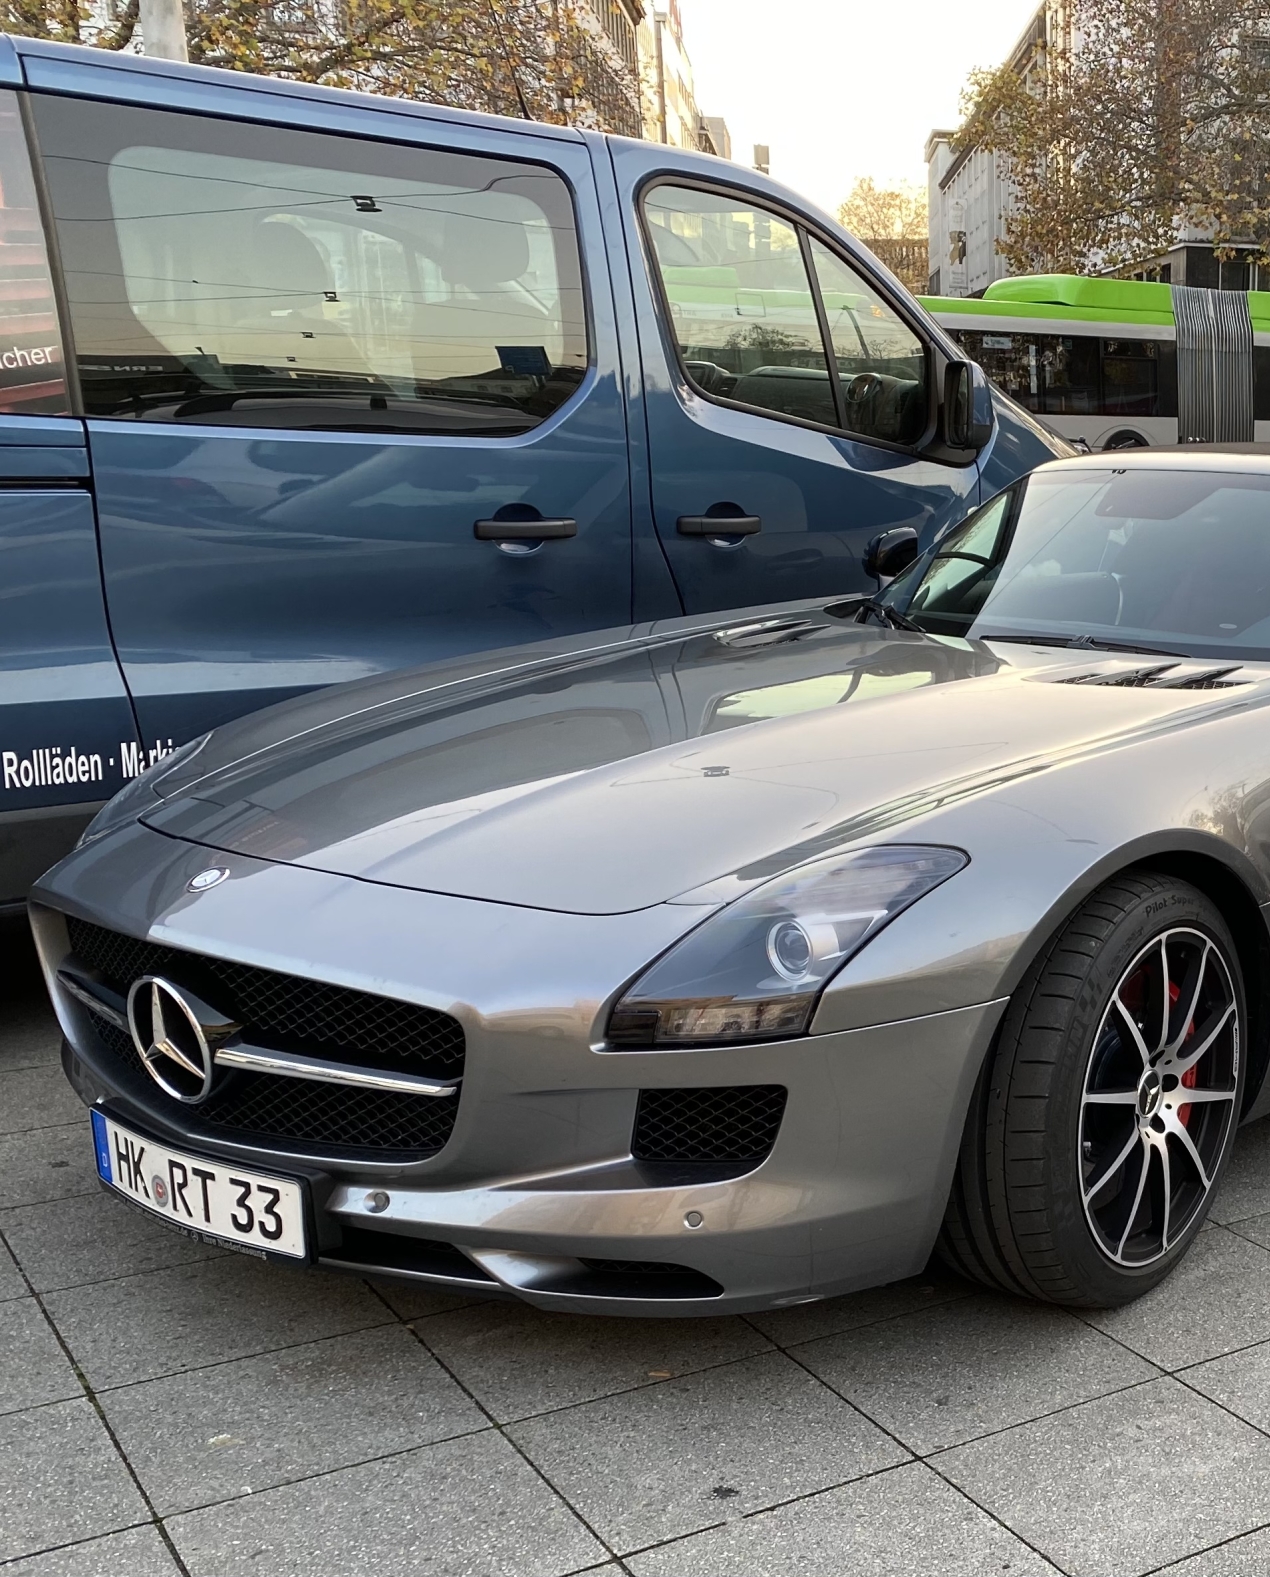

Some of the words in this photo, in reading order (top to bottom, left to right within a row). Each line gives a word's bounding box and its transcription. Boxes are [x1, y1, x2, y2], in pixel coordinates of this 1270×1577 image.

[0, 346, 53, 370] cher
[2, 746, 103, 789] Rollläden
[120, 738, 182, 779] Marki
[113, 1130, 151, 1200] HK
[168, 1158, 216, 1225] RT
[228, 1177, 283, 1241] 33
